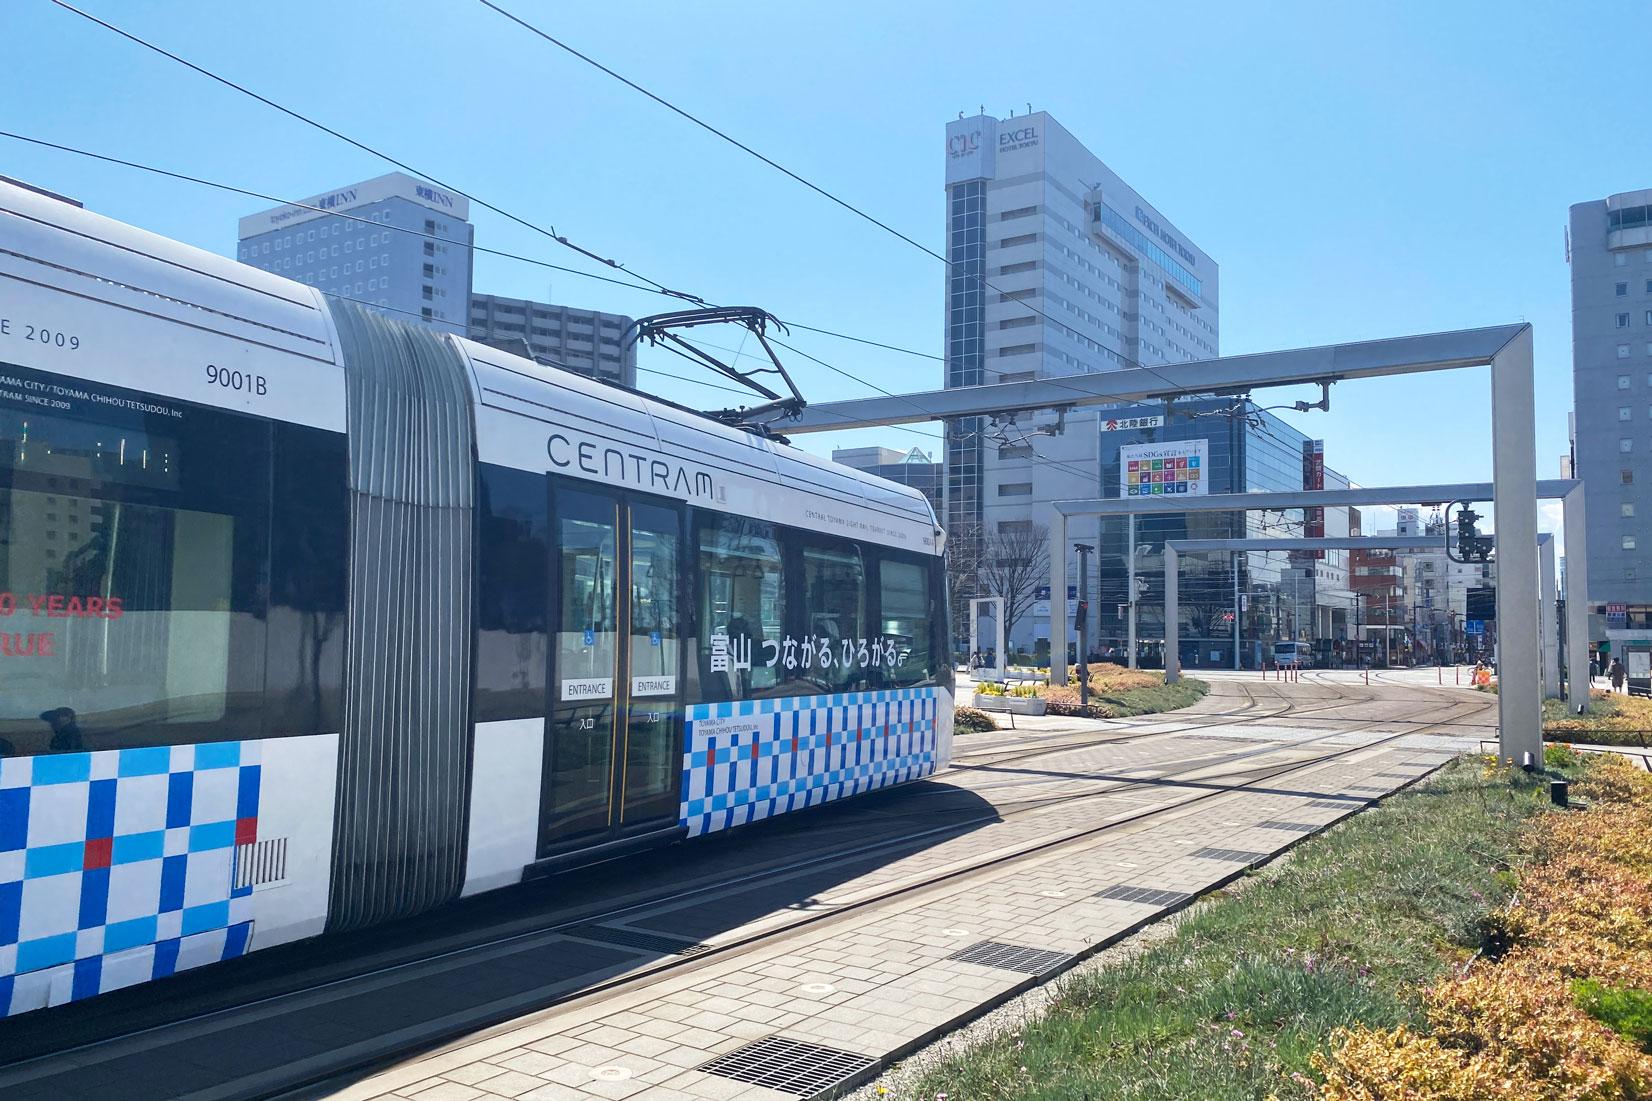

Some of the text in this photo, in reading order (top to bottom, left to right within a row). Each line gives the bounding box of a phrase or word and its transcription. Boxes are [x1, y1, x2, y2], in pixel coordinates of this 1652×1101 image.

[1000, 127, 1039, 146] EXCEL
[25, 325, 79, 350] 2009
[206, 364, 267, 396] 9001B
[24, 380, 45, 392] CITY
[52, 385, 90, 401] TOYAMA
[91, 393, 126, 407] CHIHOU
[25, 395, 49, 406] SINCE
[51, 400, 72, 410] 2009
[1120, 416, 1159, 429] 北陸銀行
[547, 434, 714, 500] CENTRAM
[27, 593, 125, 620] YEARS
[711, 633, 752, 672] 富山
[568, 683, 606, 695] ENTRANCE
[638, 681, 670, 692] ENTRANCE
[580, 718, 594, 730] 入口
[647, 712, 660, 723] 入口
